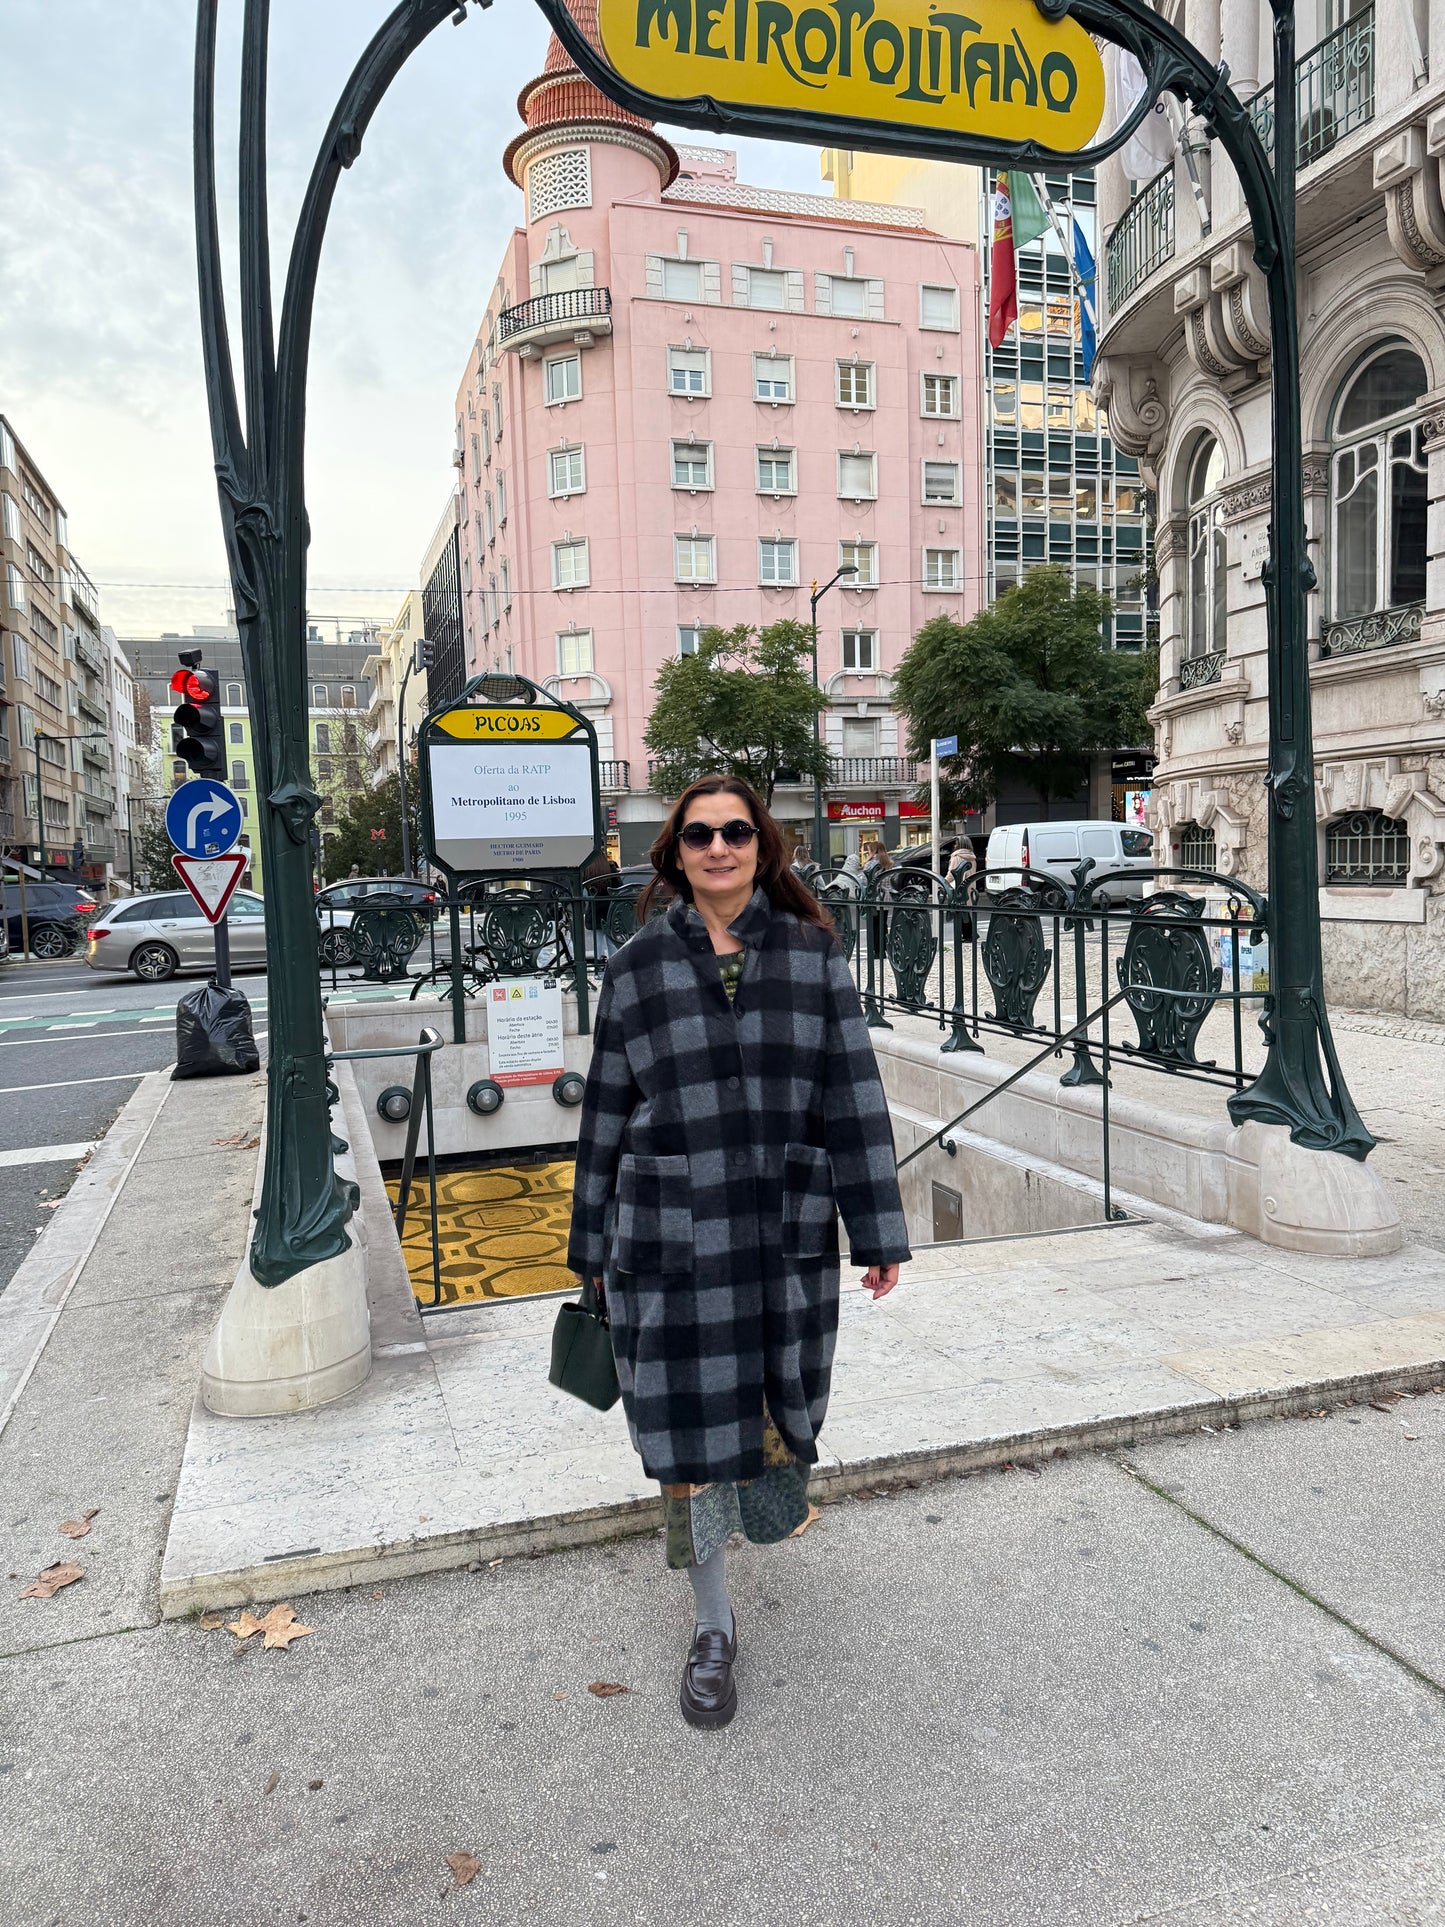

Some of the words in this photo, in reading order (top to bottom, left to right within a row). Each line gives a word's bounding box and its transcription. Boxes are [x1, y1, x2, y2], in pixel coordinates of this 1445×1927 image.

[635, 0, 1078, 113] METROPOLITANO
[474, 716, 541, 732] PICOAS
[474, 765, 505, 775] Oferta
[507, 765, 520, 775] da
[522, 765, 551, 775] RATP
[507, 784, 520, 792] ao
[451, 796, 525, 809] Metropolitano
[527, 796, 540, 806] de
[542, 795, 576, 805] Lisboa
[504, 811, 527, 821] 1995
[841, 804, 882, 816] Auchan
